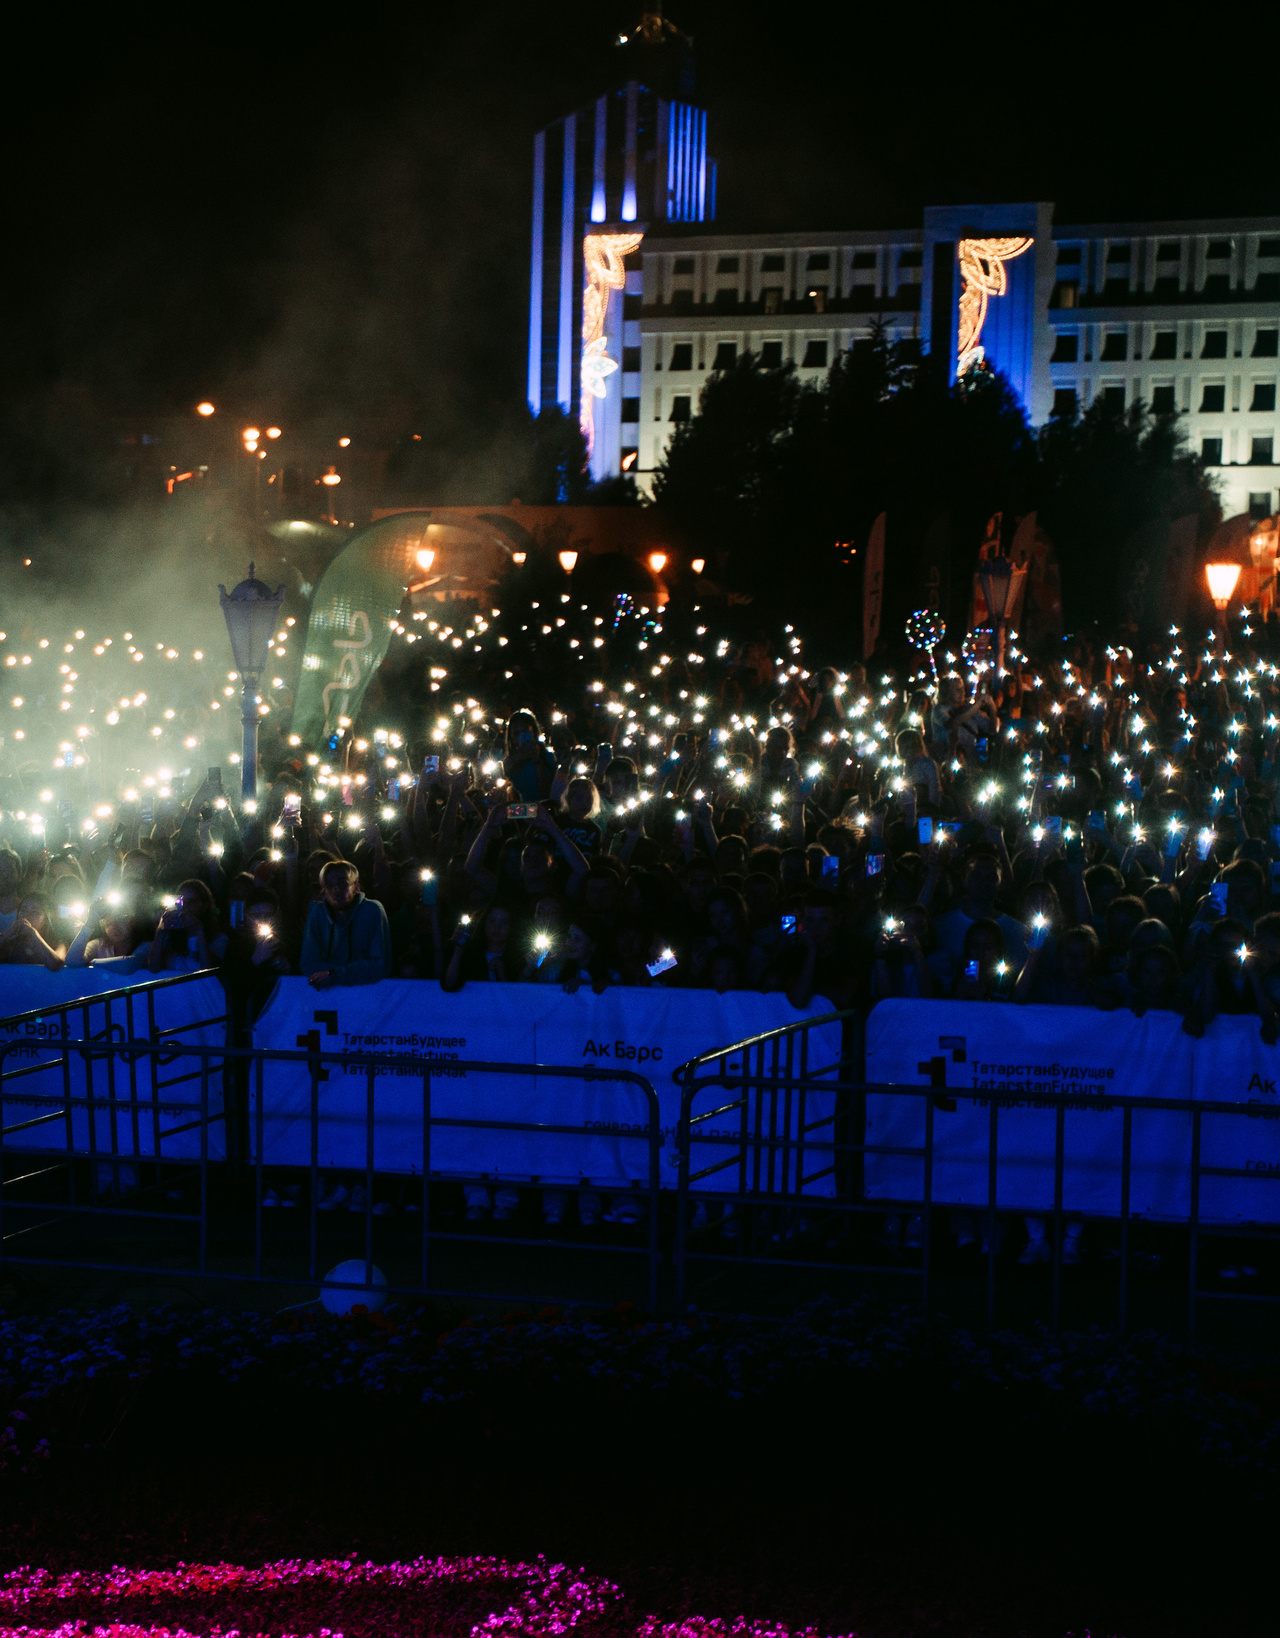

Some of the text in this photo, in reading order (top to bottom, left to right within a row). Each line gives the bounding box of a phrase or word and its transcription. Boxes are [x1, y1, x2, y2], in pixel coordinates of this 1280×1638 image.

[583, 1040, 663, 1064] Ак Барс
[1247, 1073, 1277, 1095] Ак
